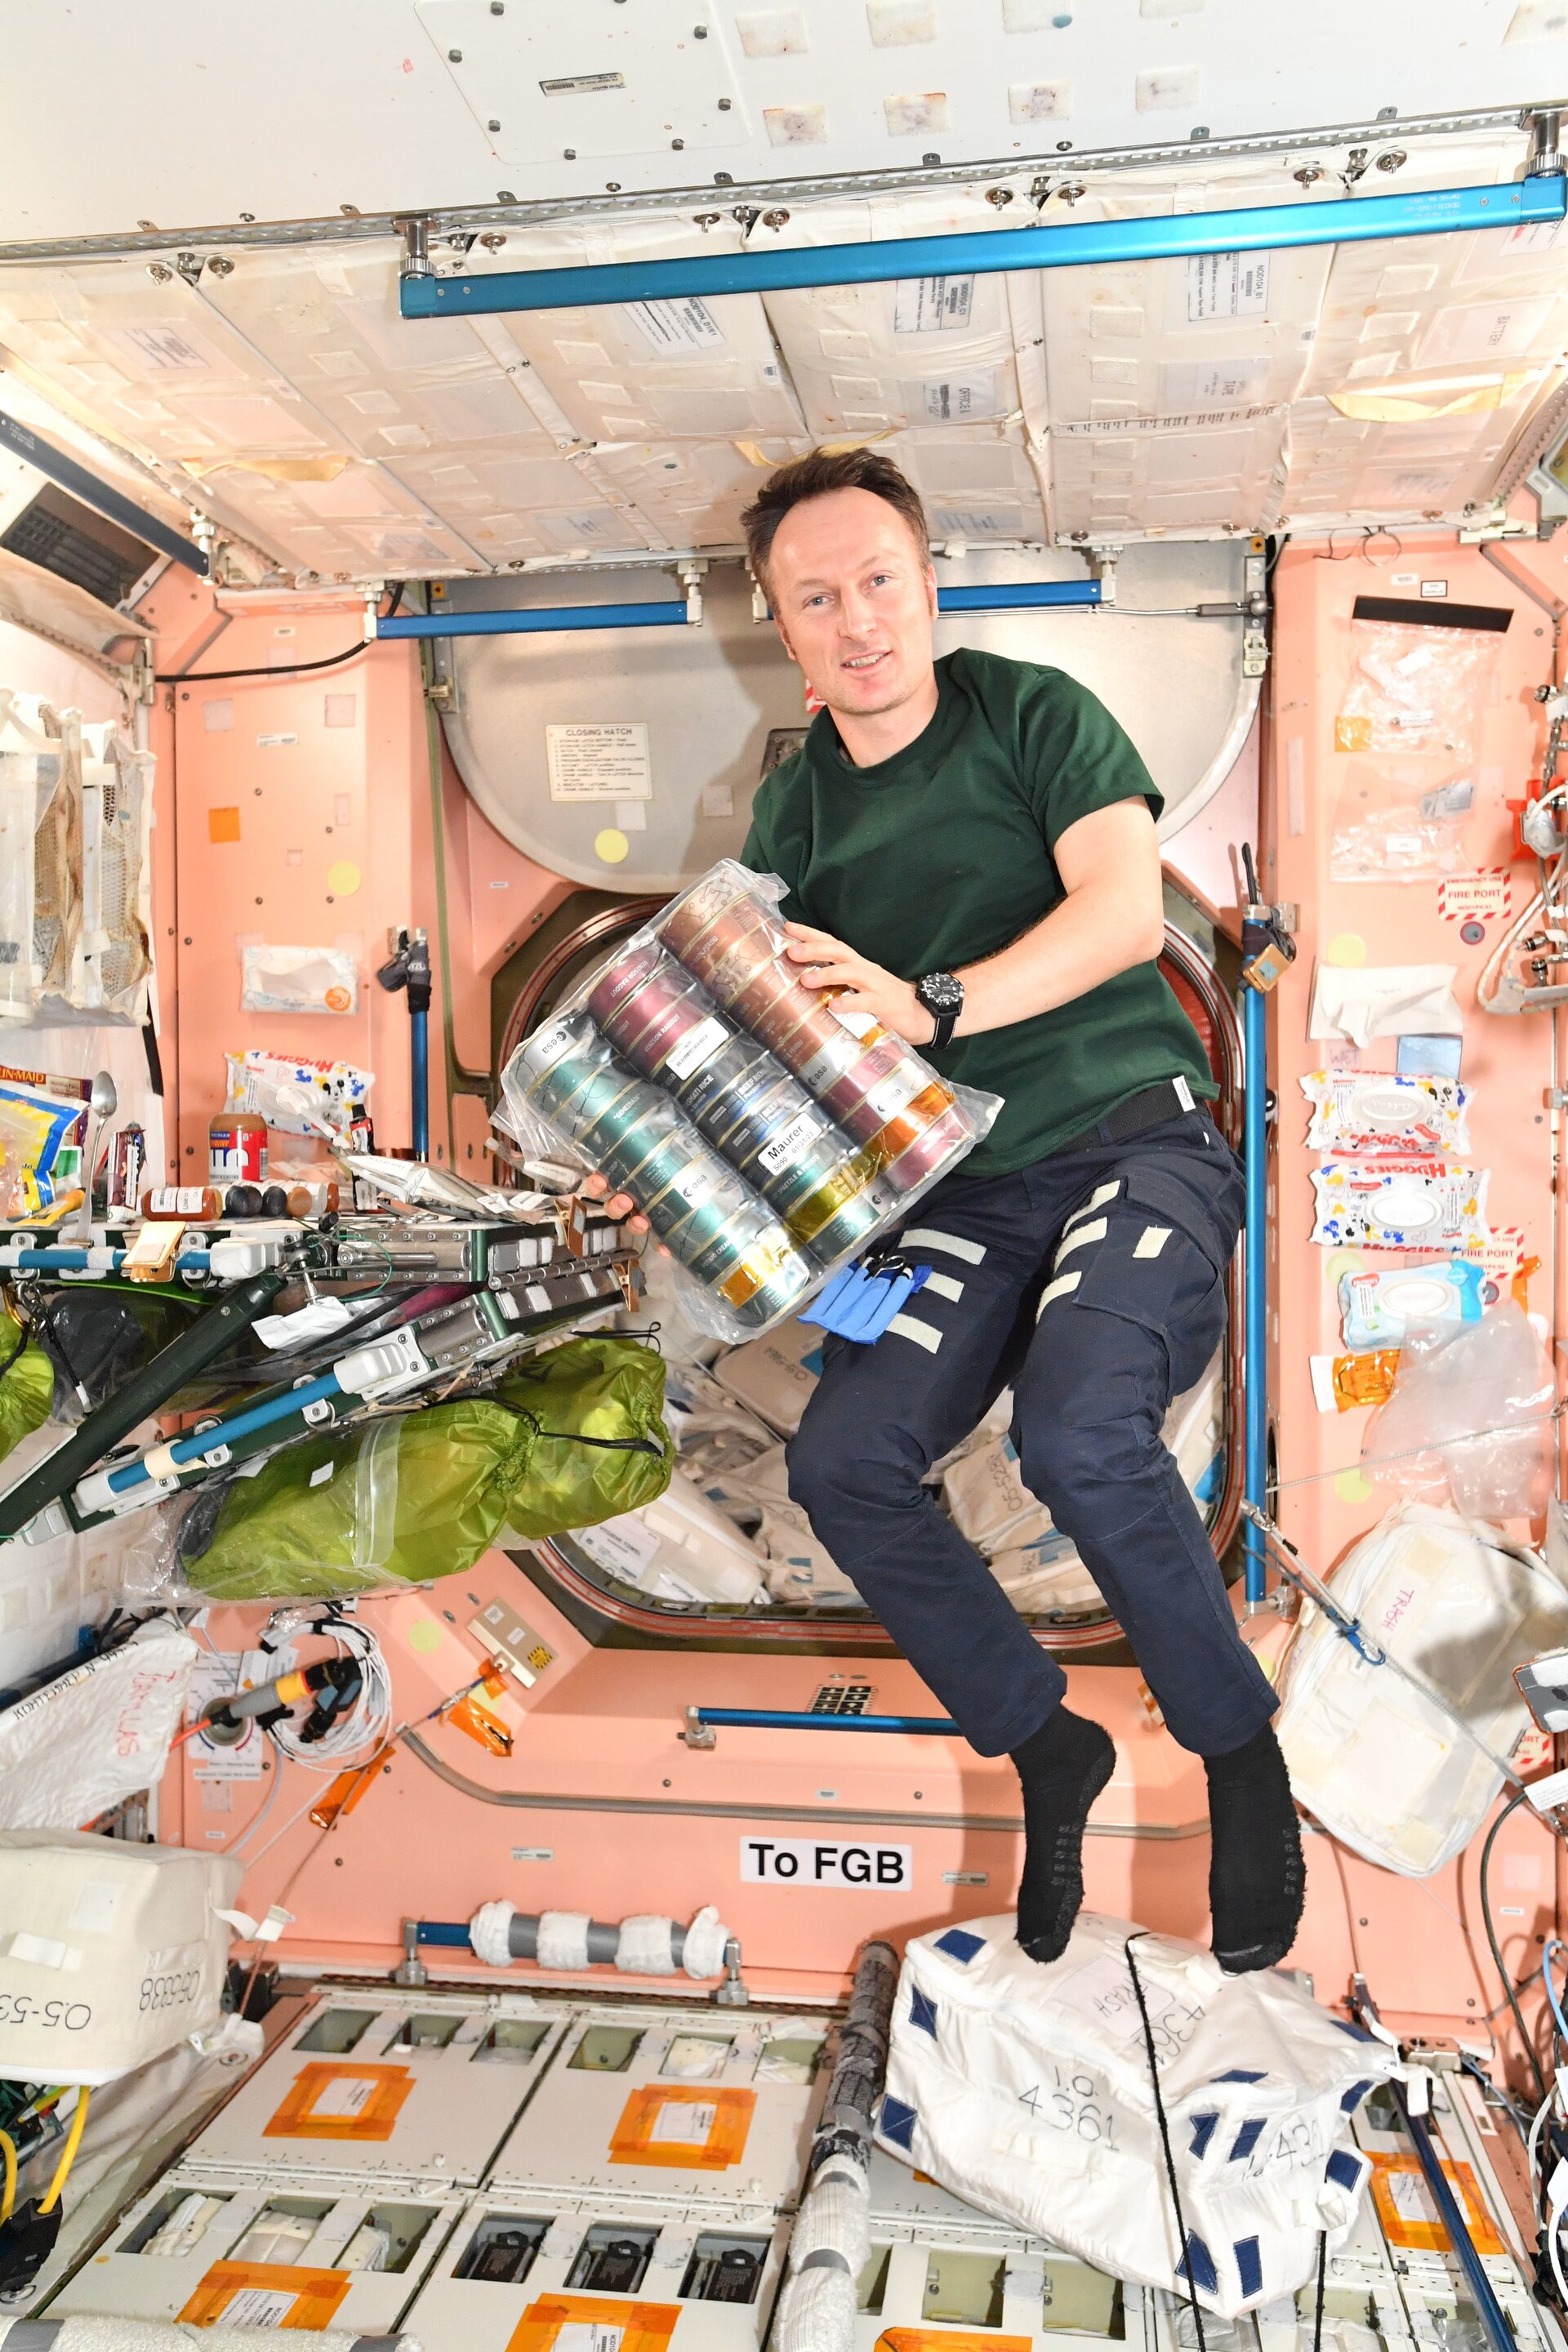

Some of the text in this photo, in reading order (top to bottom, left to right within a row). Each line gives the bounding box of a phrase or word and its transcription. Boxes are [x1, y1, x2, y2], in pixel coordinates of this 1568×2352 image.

[1487, 315, 1510, 345] BATTERY
[959, 388, 970, 409] OFFICE
[1448, 889, 1502, 898] FIRE PORT
[610, 960, 649, 998] VENISON RAGOUT
[644, 1014, 680, 1053] VENISON RAGOUT
[542, 1036, 559, 1054] esa
[265, 1051, 336, 1072] HUGGIES
[665, 1072, 677, 1087] esa
[699, 1074, 715, 1090] RICE
[815, 1065, 828, 1080] esa
[737, 1078, 756, 1095] BEEF
[761, 1104, 777, 1119] BEEF
[768, 1124, 804, 1160] Maurer
[773, 1131, 815, 1172] S090 01/31/23
[801, 1153, 820, 1174] POTATO
[1364, 1163, 1446, 1178] HUGGIES
[691, 1174, 707, 1190] esa
[1461, 1249, 1514, 1258] FIRE PORT
[1381, 1588, 1416, 1633] TRASH
[1518, 1735, 1540, 1744] ORT
[748, 1843, 904, 1886] To FGB
[1018, 2085, 1120, 2152] 4361
